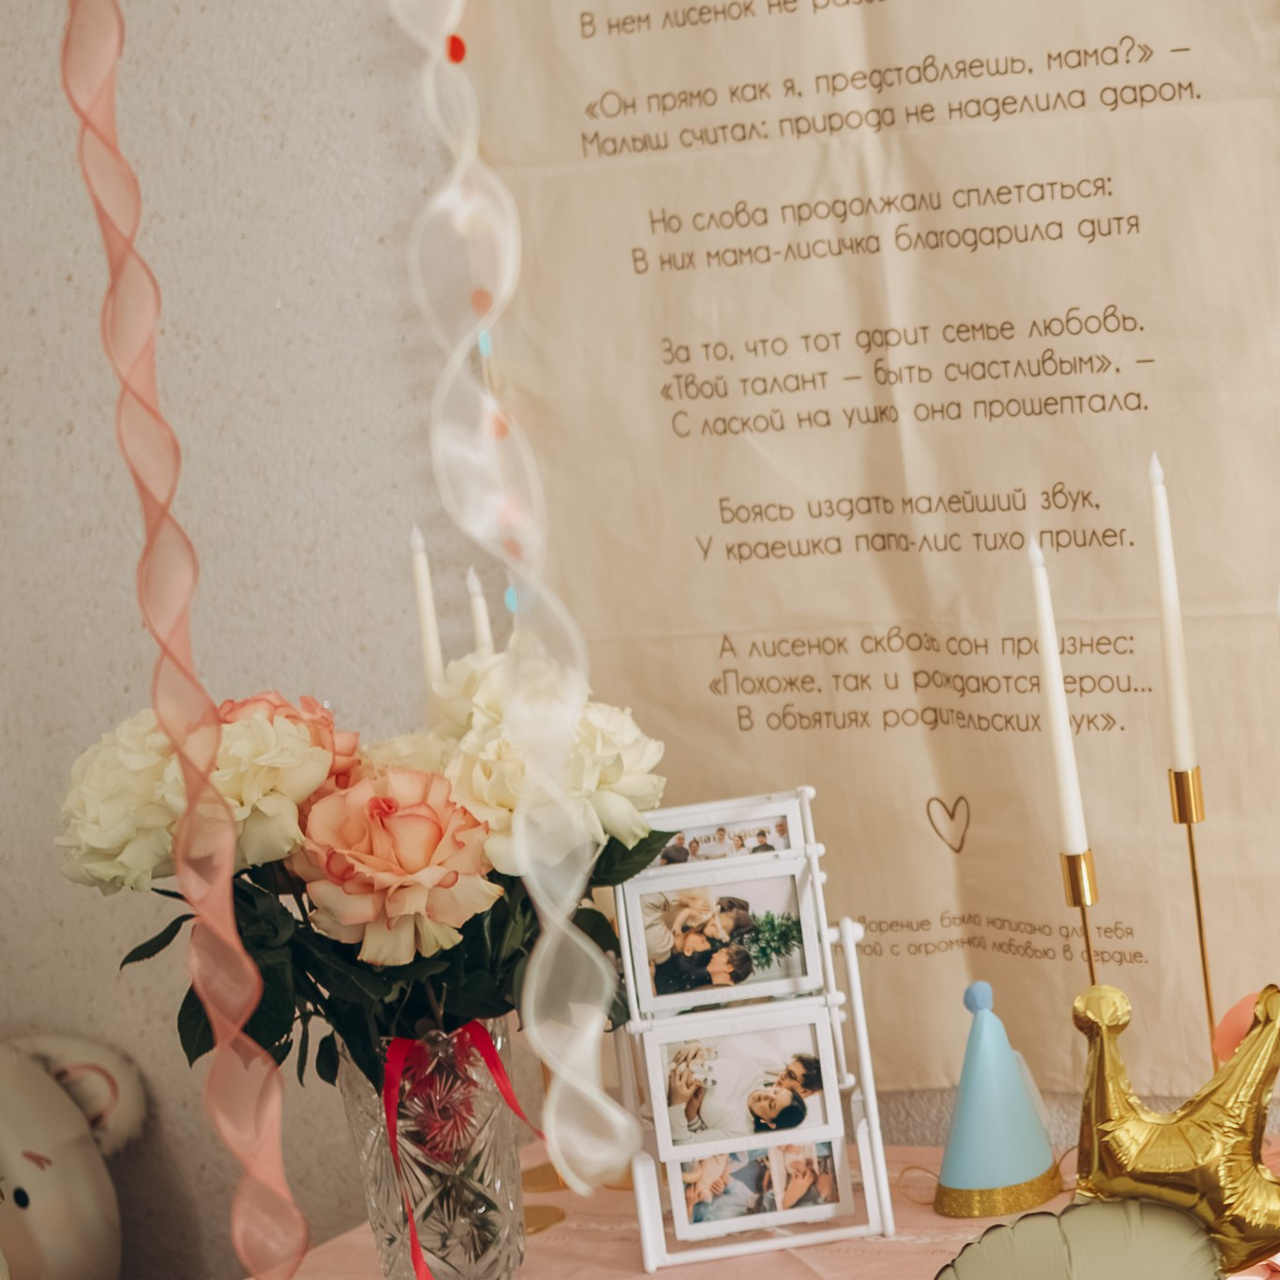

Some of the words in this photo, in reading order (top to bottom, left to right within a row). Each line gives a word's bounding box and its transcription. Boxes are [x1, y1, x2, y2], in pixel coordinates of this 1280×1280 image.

[580, 12, 596, 39] В
[607, 14, 651, 34] нем
[663, 1, 755, 28] лисенок
[585, 91, 636, 119] «Он
[647, 88, 718, 115] прямо
[729, 83, 770, 103] как
[1047, 35, 1154, 70] мама?»
[581, 131, 668, 156] Малыш
[679, 121, 769, 148] считал:
[779, 107, 895, 139] природа
[905, 103, 935, 123] не
[948, 89, 1086, 122] наделила
[1099, 81, 1201, 112] даром.
[649, 209, 682, 234] Но
[692, 200, 768, 231] слова
[781, 193, 941, 226] продолжали
[952, 177, 1113, 209] сплетаться:
[632, 248, 649, 274] В
[660, 253, 694, 271] них
[706, 235, 881, 267] мама-лисичка
[895, 221, 1063, 253] благодарила
[1077, 215, 1139, 244] дитя
[662, 337, 691, 365] За
[702, 342, 734, 361] то,
[745, 337, 788, 356] что
[801, 332, 841, 352] тот
[855, 325, 929, 354] дарит
[942, 321, 1015, 343] семье
[1029, 304, 1144, 338] любовь.
[661, 374, 728, 400] «Твой
[739, 371, 828, 396] талант
[874, 358, 932, 386] быть
[672, 410, 690, 438] С
[701, 409, 785, 436] лаской
[797, 409, 831, 428] на
[843, 405, 898, 428] ушко
[913, 401, 962, 422] она
[973, 391, 1148, 422] прошептала.
[719, 497, 794, 524] Боясь
[807, 496, 894, 521] издать
[901, 488, 1027, 515] малейший
[1041, 481, 1100, 512] звук,
[696, 536, 712, 560] У
[726, 536, 842, 564] краешка
[855, 533, 961, 552] папа-лис
[972, 531, 1025, 552] тихо
[1039, 528, 1134, 552] прилег.
[719, 634, 737, 658] А
[749, 637, 847, 657] лисенок
[861, 626, 940, 656] сквозь
[946, 636, 989, 656] сон
[709, 669, 822, 695] «Похоже,
[832, 674, 871, 692] так
[884, 673, 899, 690] и
[913, 669, 1041, 698] рождаются
[1063, 674, 1153, 697] ерои...
[737, 705, 754, 731] В
[766, 703, 870, 730] объятиях
[883, 706, 1041, 732] родительских
[1069, 713, 1125, 735] ук».
[907, 935, 986, 957] огромной
[1062, 944, 1074, 961] в
[986, 916, 1053, 937] написано
[1096, 921, 1134, 940] тебя
